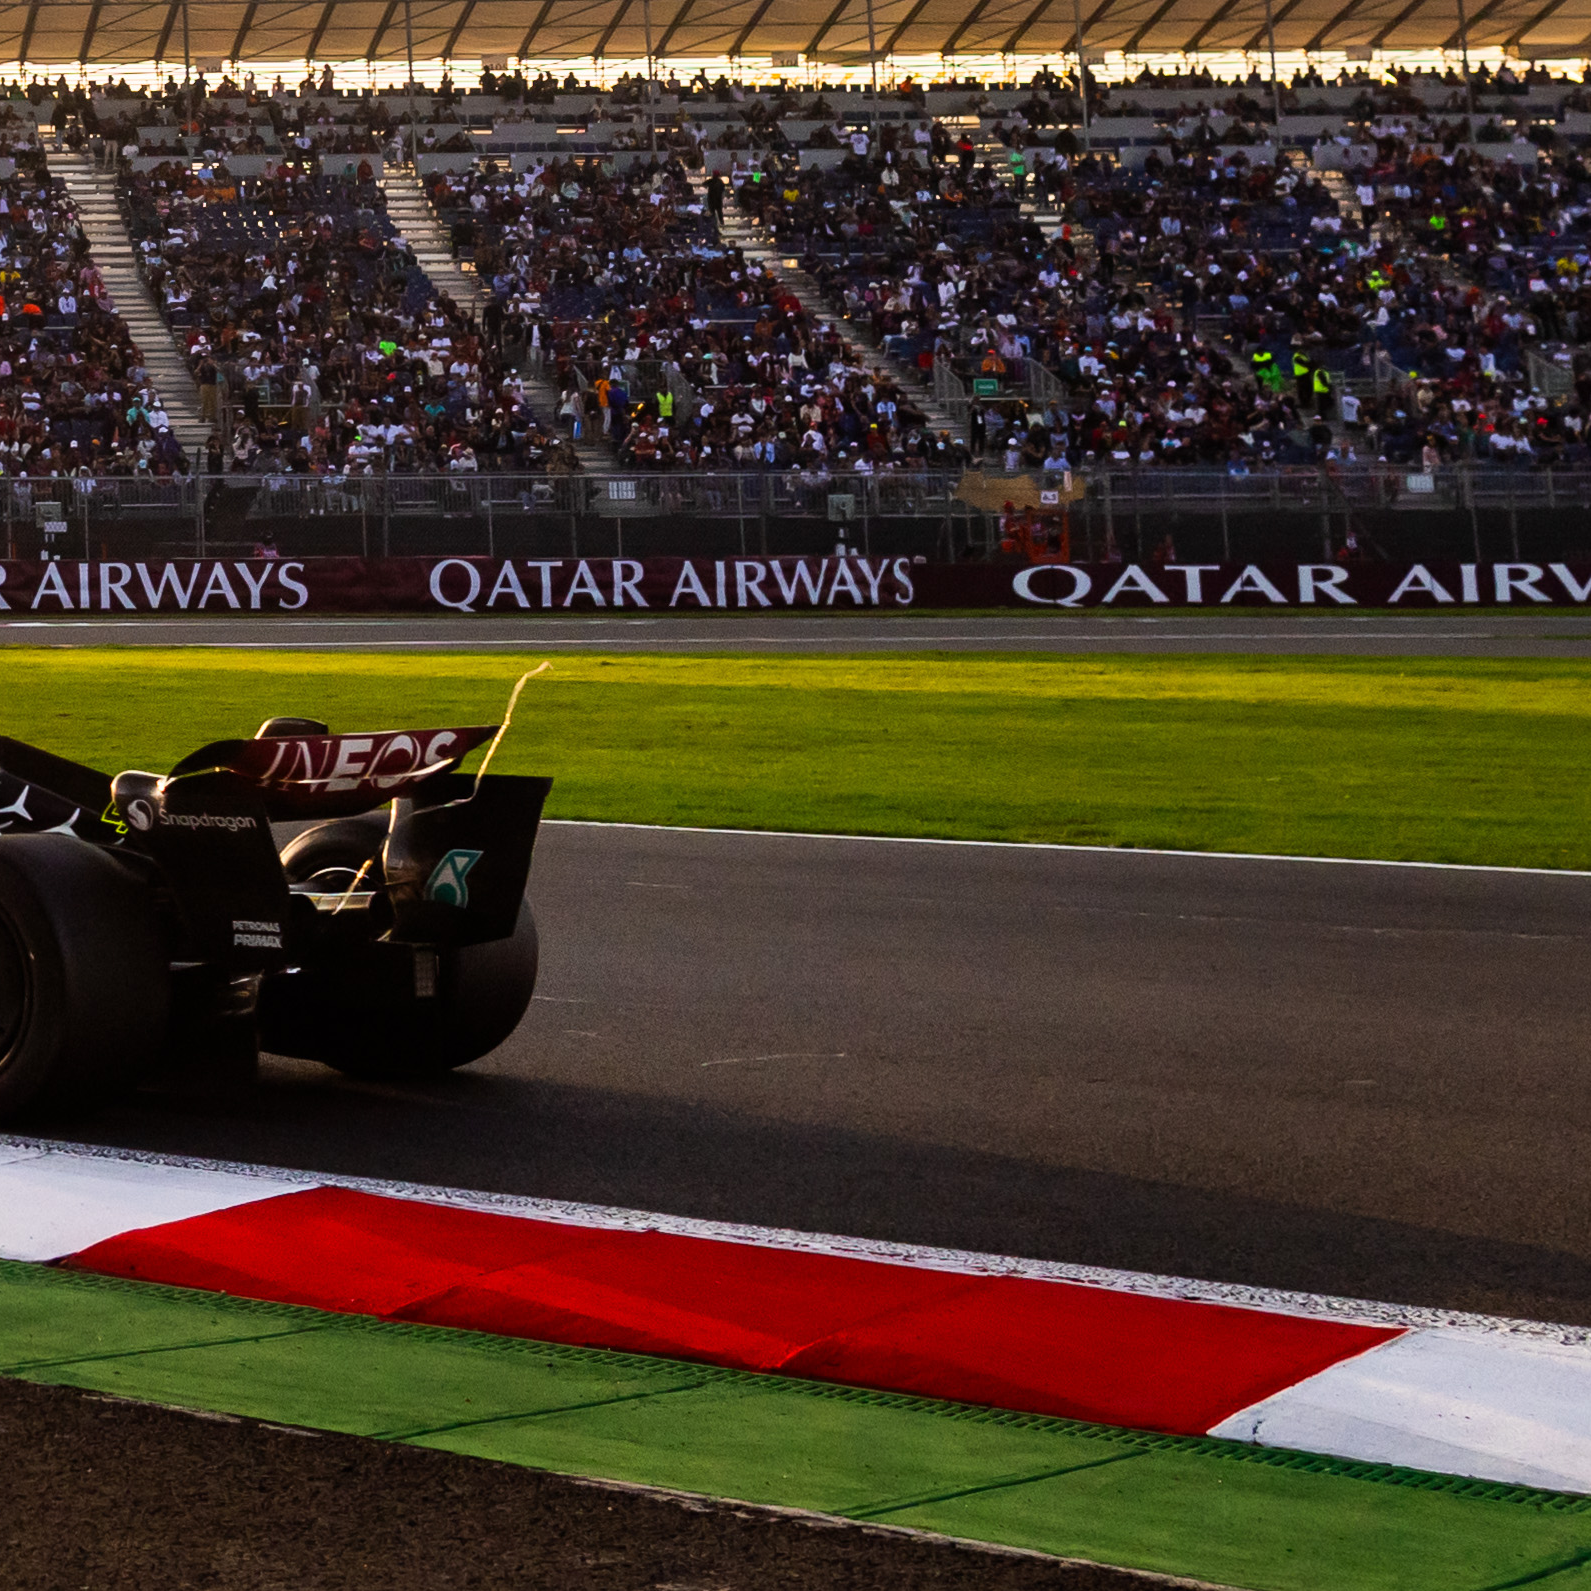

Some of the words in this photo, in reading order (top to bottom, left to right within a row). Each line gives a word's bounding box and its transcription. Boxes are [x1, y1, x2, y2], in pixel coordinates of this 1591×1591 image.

[31, 561, 309, 610] AIRWAYS
[429, 559, 649, 612] QATAR
[670, 557, 915, 607] AIRWAYS
[1012, 564, 1358, 608] QATAR
[255, 730, 458, 793] INEOS
[158, 807, 257, 832] Snapdragon
[232, 919, 281, 933] PETRONAS
